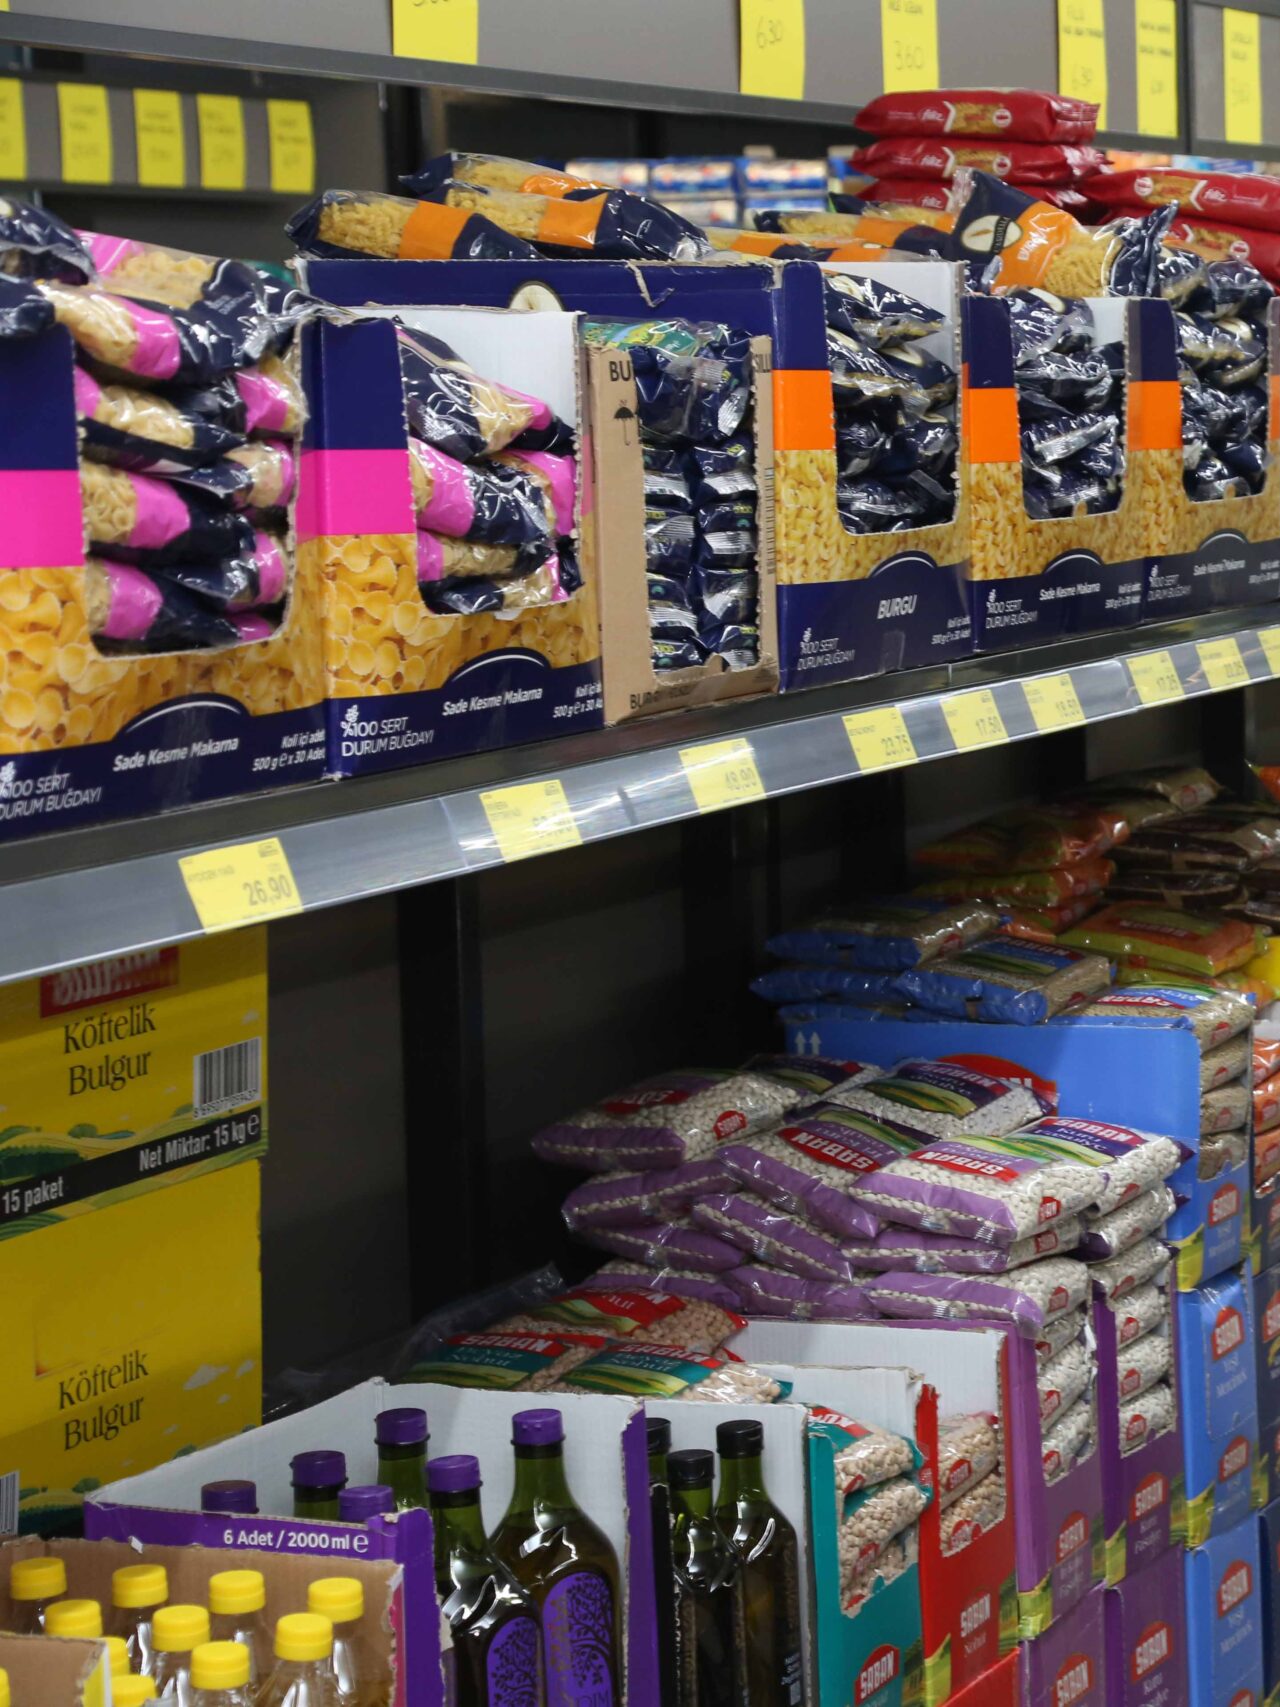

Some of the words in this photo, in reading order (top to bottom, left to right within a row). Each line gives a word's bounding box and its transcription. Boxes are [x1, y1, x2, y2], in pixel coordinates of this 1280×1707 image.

[877, 594, 917, 619] BURGU
[442, 701, 468, 718] Sade
[469, 693, 502, 711] Kesme
[504, 686, 543, 706] Makarna
[379, 715, 409, 733] SERT
[113, 750, 144, 772] Sade
[147, 744, 188, 766] Kesme
[191, 738, 239, 759] Makarna
[281, 733, 298, 749] Koli
[341, 735, 388, 757] DURUM
[389, 729, 434, 751] BUĞDAYI
[252, 755, 269, 772] 500
[294, 750, 305, 764] 30
[306, 747, 325, 762] Adet
[36, 772, 71, 792] SERT
[45, 787, 103, 813] BUĞDAYI
[242, 874, 292, 907] 26,90
[63, 1002, 156, 1054] Köftelik
[69, 1051, 152, 1096] Bulgur
[1055, 1118, 1136, 1142] SABAN
[140, 1148, 162, 1171] Net
[165, 1132, 211, 1164] Miktar:
[214, 1124, 230, 1146] 15
[232, 1121, 246, 1145] kg
[791, 1131, 875, 1170] SABAN
[918, 1151, 1005, 1175] SABAN
[2, 1186, 20, 1214] 15
[24, 1176, 64, 1209] paket
[461, 1335, 553, 1353] SABAN
[621, 1344, 709, 1364] SABAN
[58, 1349, 150, 1410] Köftelik
[64, 1396, 145, 1451] Bulgur
[223, 1529, 234, 1545] 6
[237, 1529, 273, 1546] Adet
[275, 1530, 285, 1548] /
[288, 1531, 330, 1549] 2000
[332, 1533, 350, 1550] ml
[960, 1592, 991, 1639] SABAN
[860, 1650, 895, 1700] SABAN
